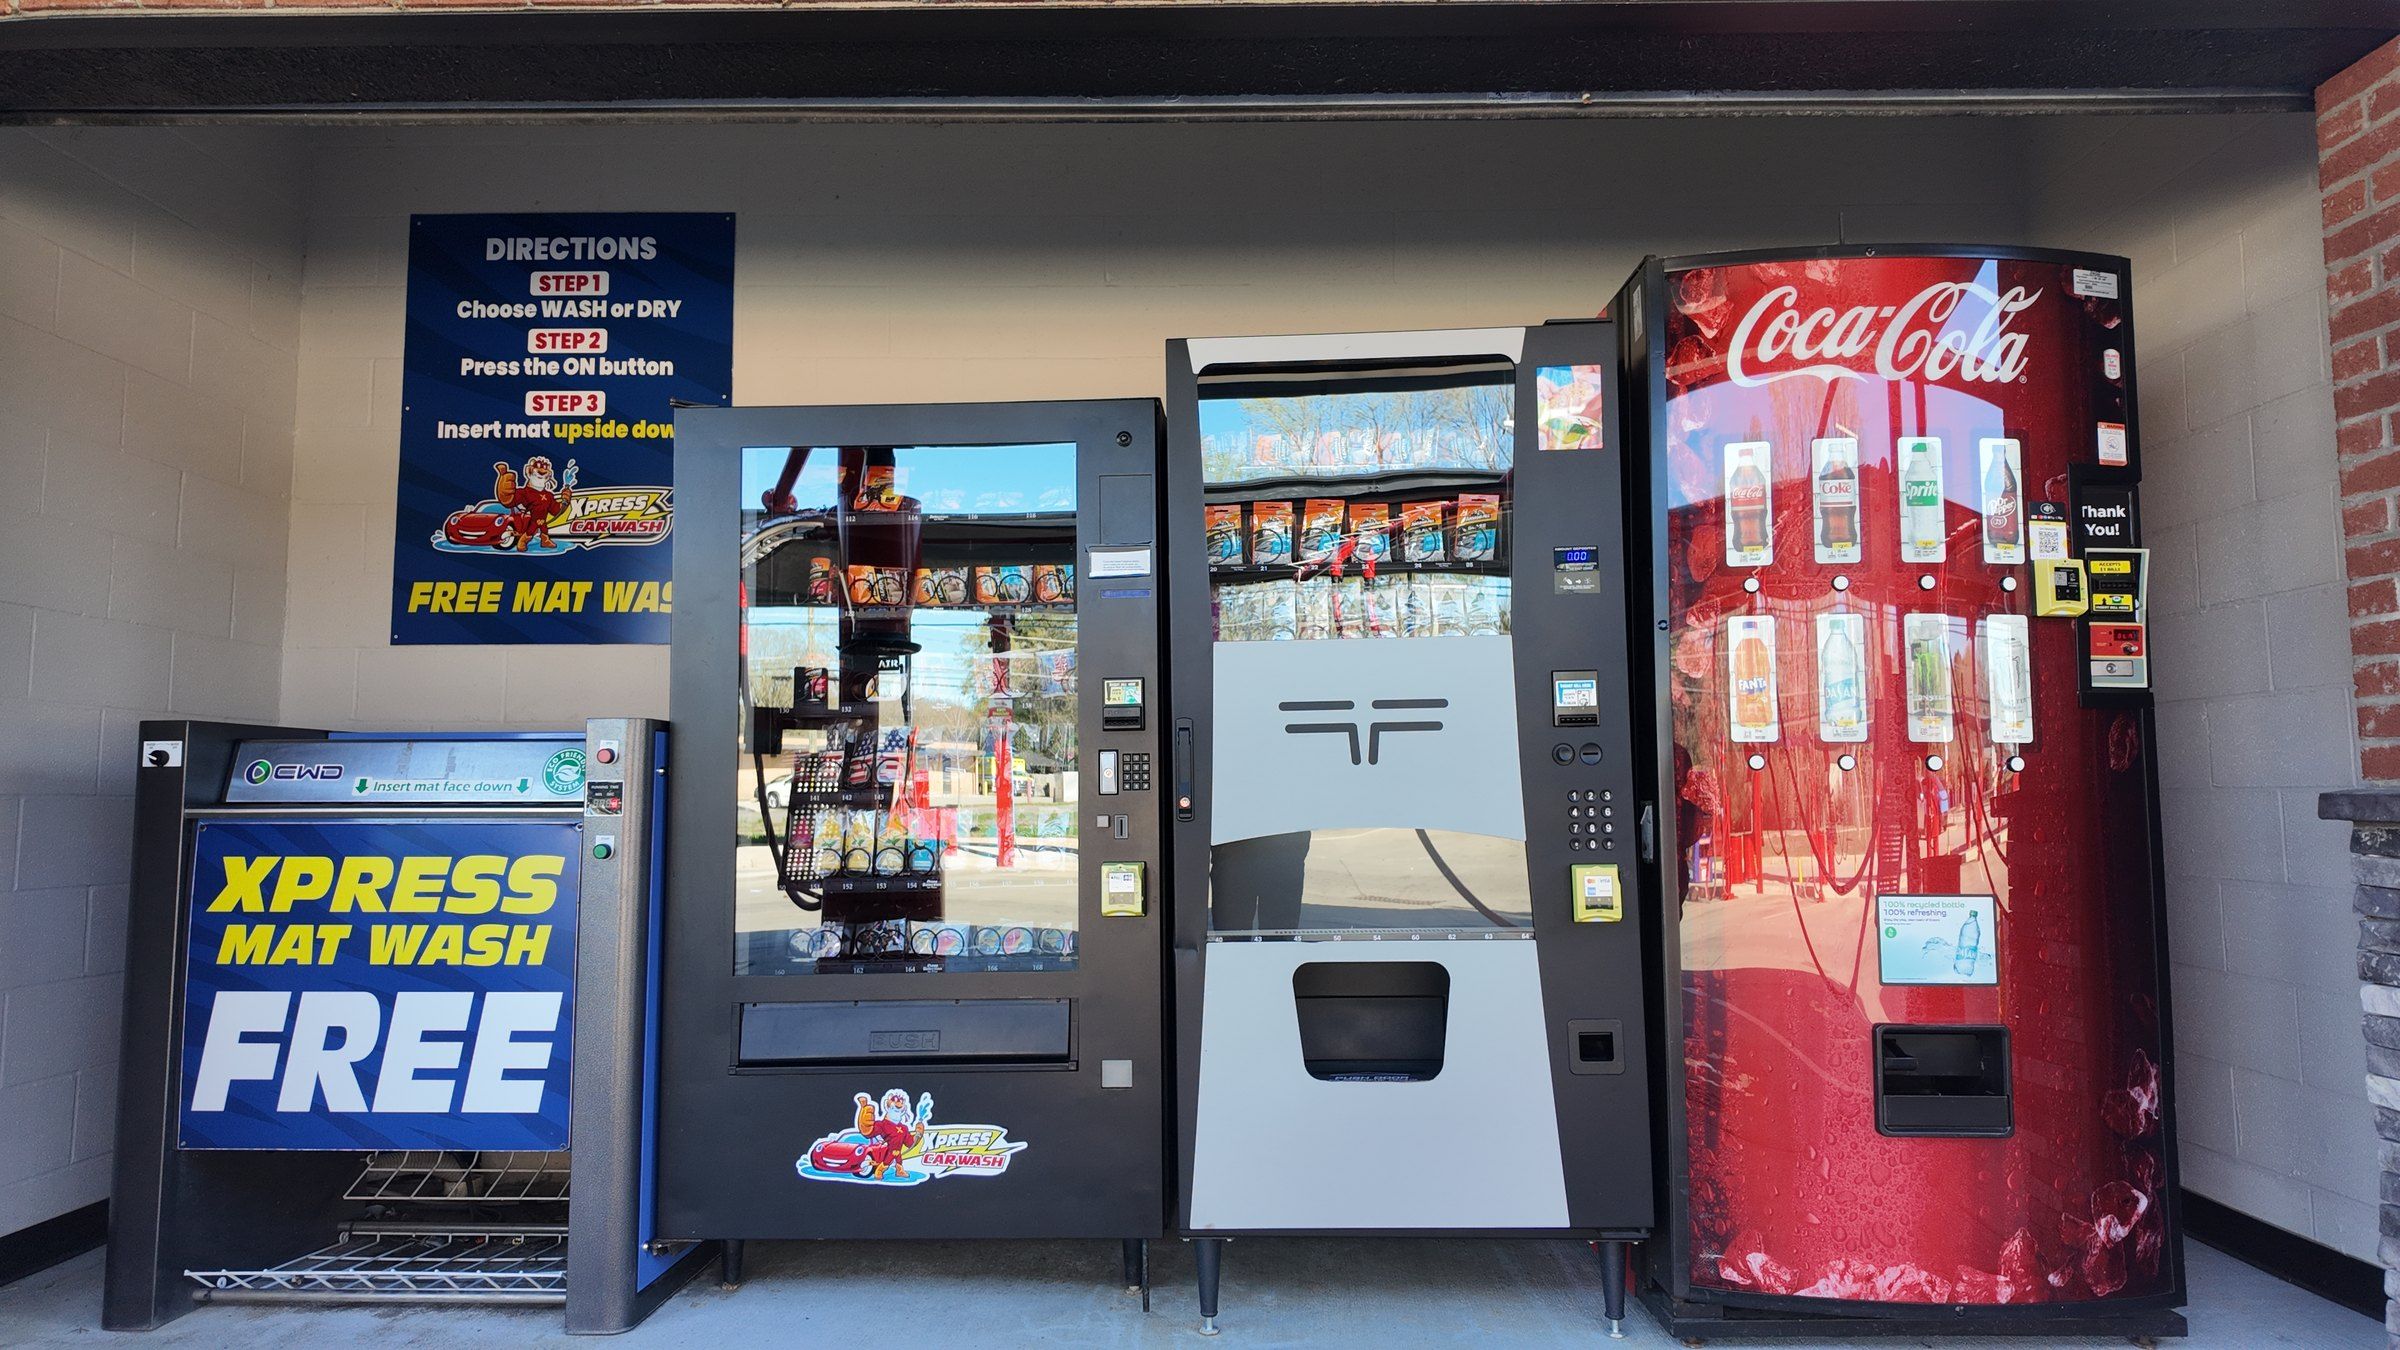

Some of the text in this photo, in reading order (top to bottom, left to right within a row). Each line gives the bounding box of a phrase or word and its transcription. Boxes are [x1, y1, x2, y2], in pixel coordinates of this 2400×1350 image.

[486, 237, 657, 261] DIRECTIONS
[539, 275, 601, 292] STEP 1
[457, 300, 681, 319] Choose WASH or DRY
[535, 332, 601, 349] STEP 2
[1727, 282, 2043, 387] Coca-Cola
[461, 358, 673, 376] Press the ON button
[532, 395, 598, 412] STEP 3
[437, 419, 674, 444] Insert mat upside dow
[1822, 482, 1851, 494] Coke
[570, 495, 648, 520] XPRESS
[2081, 505, 2126, 518] Thank
[571, 520, 663, 533] CAR WASH
[2084, 524, 2120, 536] You!
[408, 582, 503, 613] FREE
[512, 582, 592, 613] MAT
[878, 659, 899, 668] AIR
[547, 755, 559, 772] ECO
[273, 764, 344, 780] CWD
[373, 780, 513, 793] Insert mat face down
[550, 780, 580, 792] SYSTEM
[1572, 792, 1610, 800] 1 2 3
[1572, 808, 1611, 816] 4 5 6
[1573, 824, 1612, 832] 7 8 9
[1590, 840, 1595, 848] 0
[206, 855, 565, 914] XPRESS
[1907, 900, 1940, 909] recycled
[1908, 908, 1947, 917] refreshing
[216, 924, 552, 966] MAT WASH
[191, 991, 563, 1113] FREE
[923, 1132, 992, 1150] XPRESS
[922, 1153, 1004, 1168] CAR WASH
